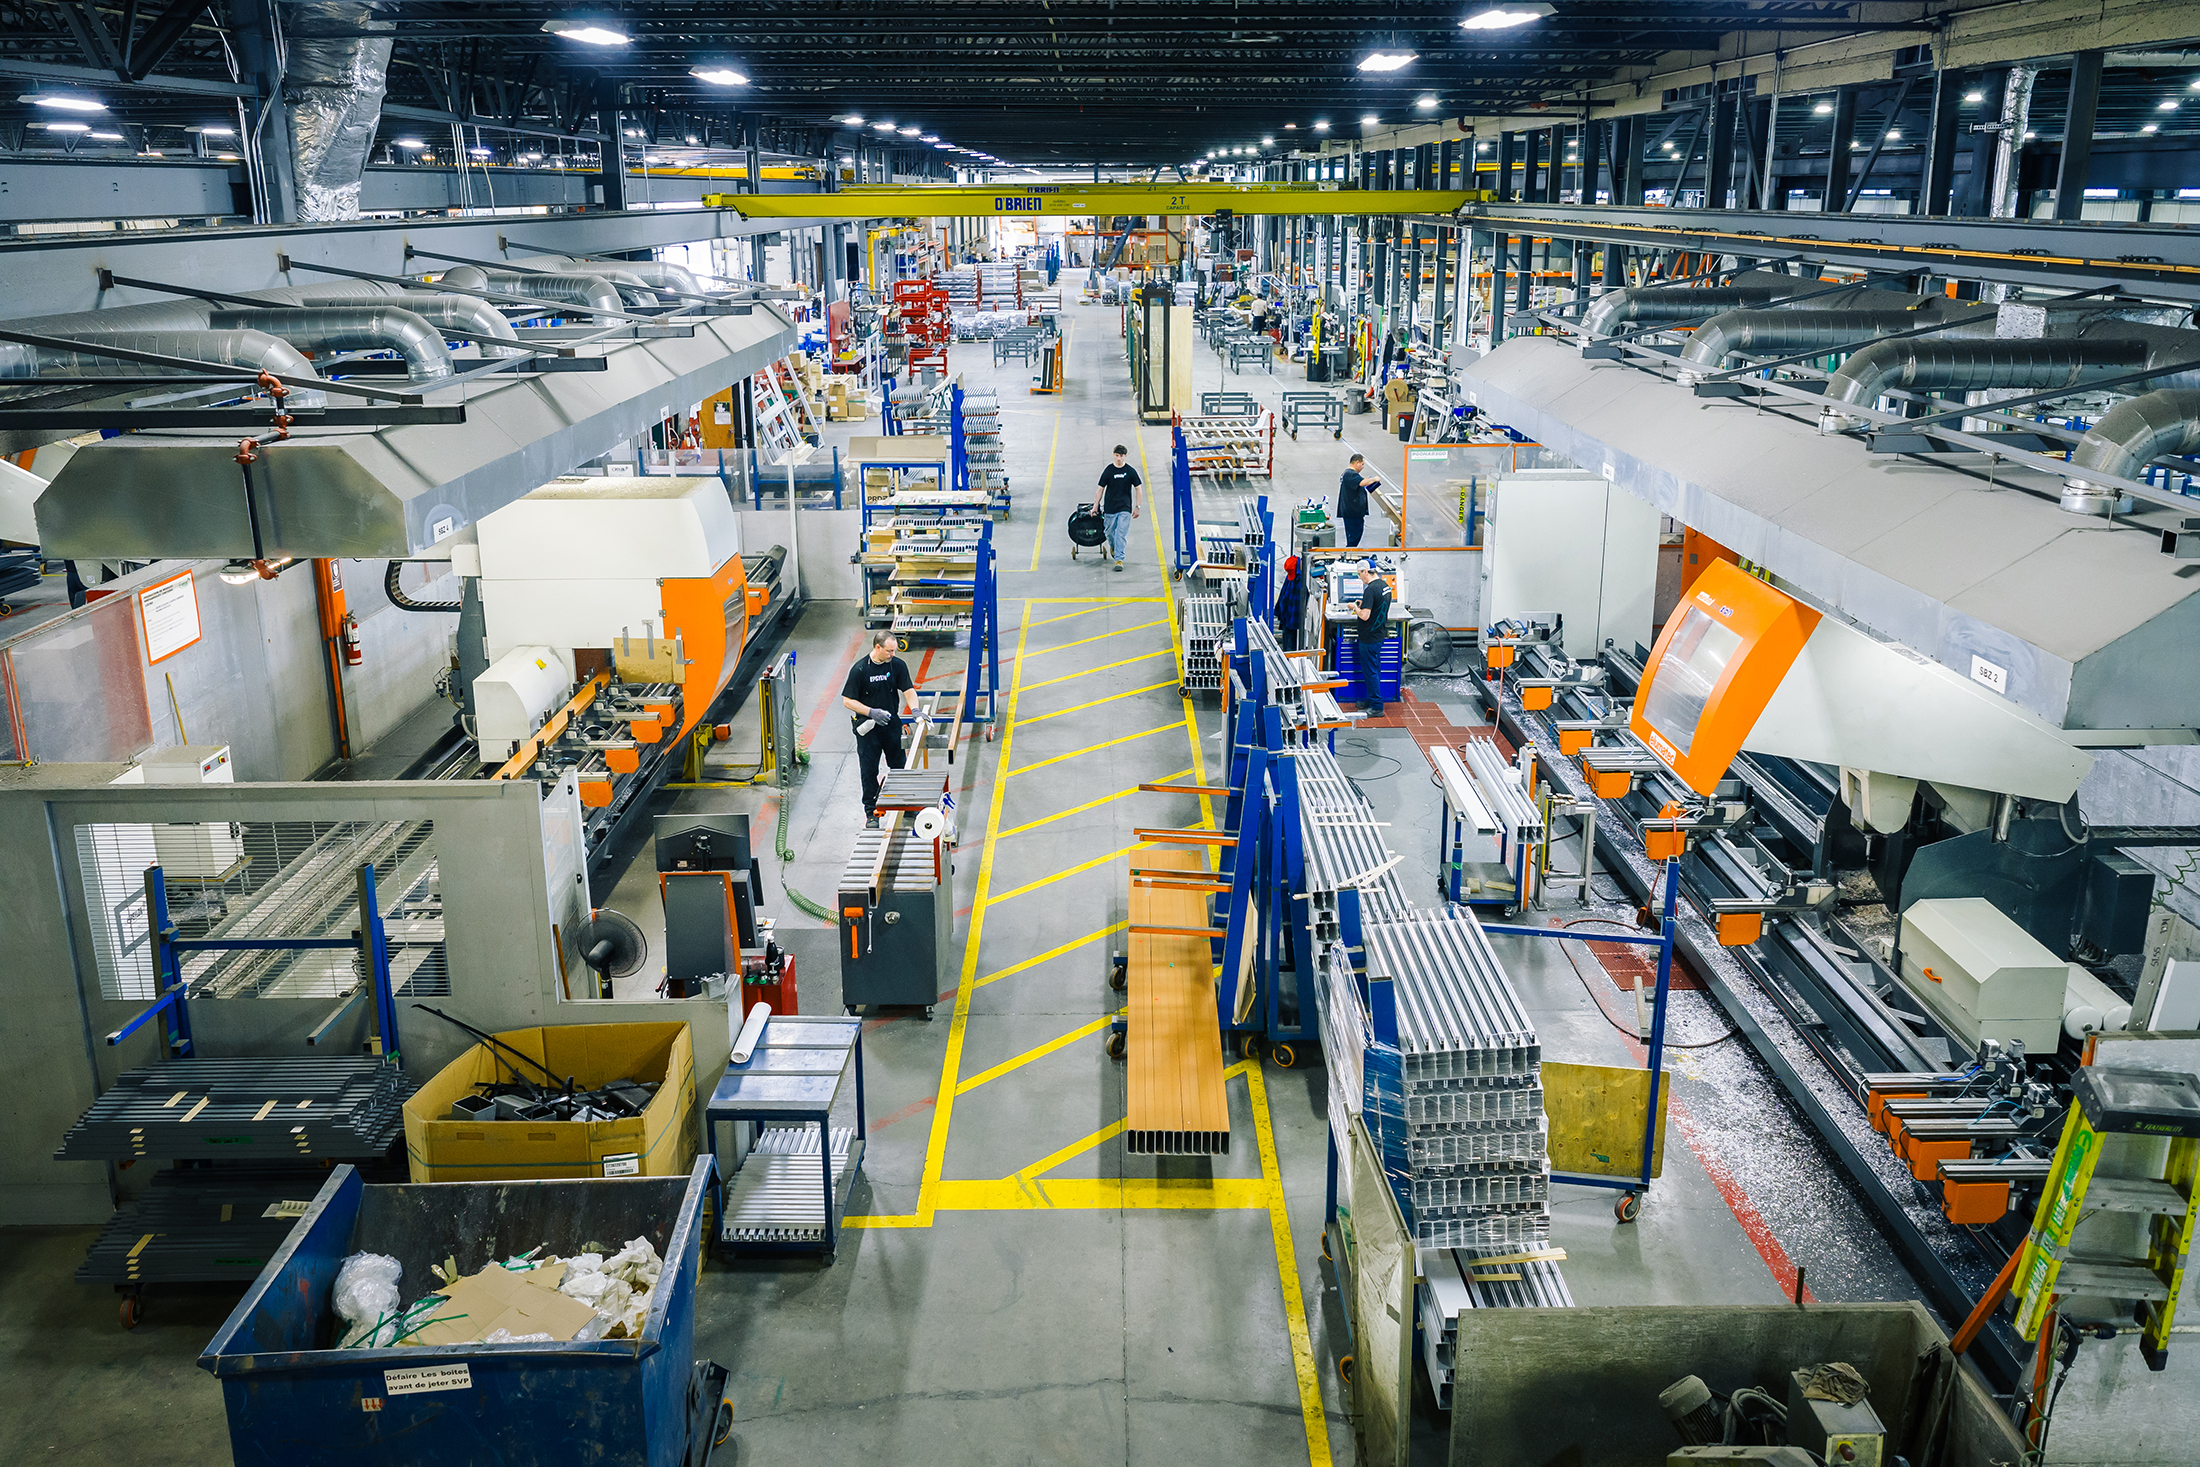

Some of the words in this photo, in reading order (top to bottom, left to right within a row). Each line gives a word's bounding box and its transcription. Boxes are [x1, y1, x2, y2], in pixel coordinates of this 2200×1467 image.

[995, 197, 1042, 211] O'BRIEN
[1171, 196, 1177, 205] 2
[1179, 196, 1185, 205] T
[1458, 491, 1466, 521] DANGER
[1979, 666, 1993, 681] SBZ
[1993, 673, 1998, 683] 2
[1650, 735, 1675, 764] elumatec
[2143, 1123, 2183, 1133] FEATHERLITE
[386, 1373, 418, 1382] Défaire
[388, 1383, 413, 1391] avant
[428, 1380, 449, 1389] jeter
